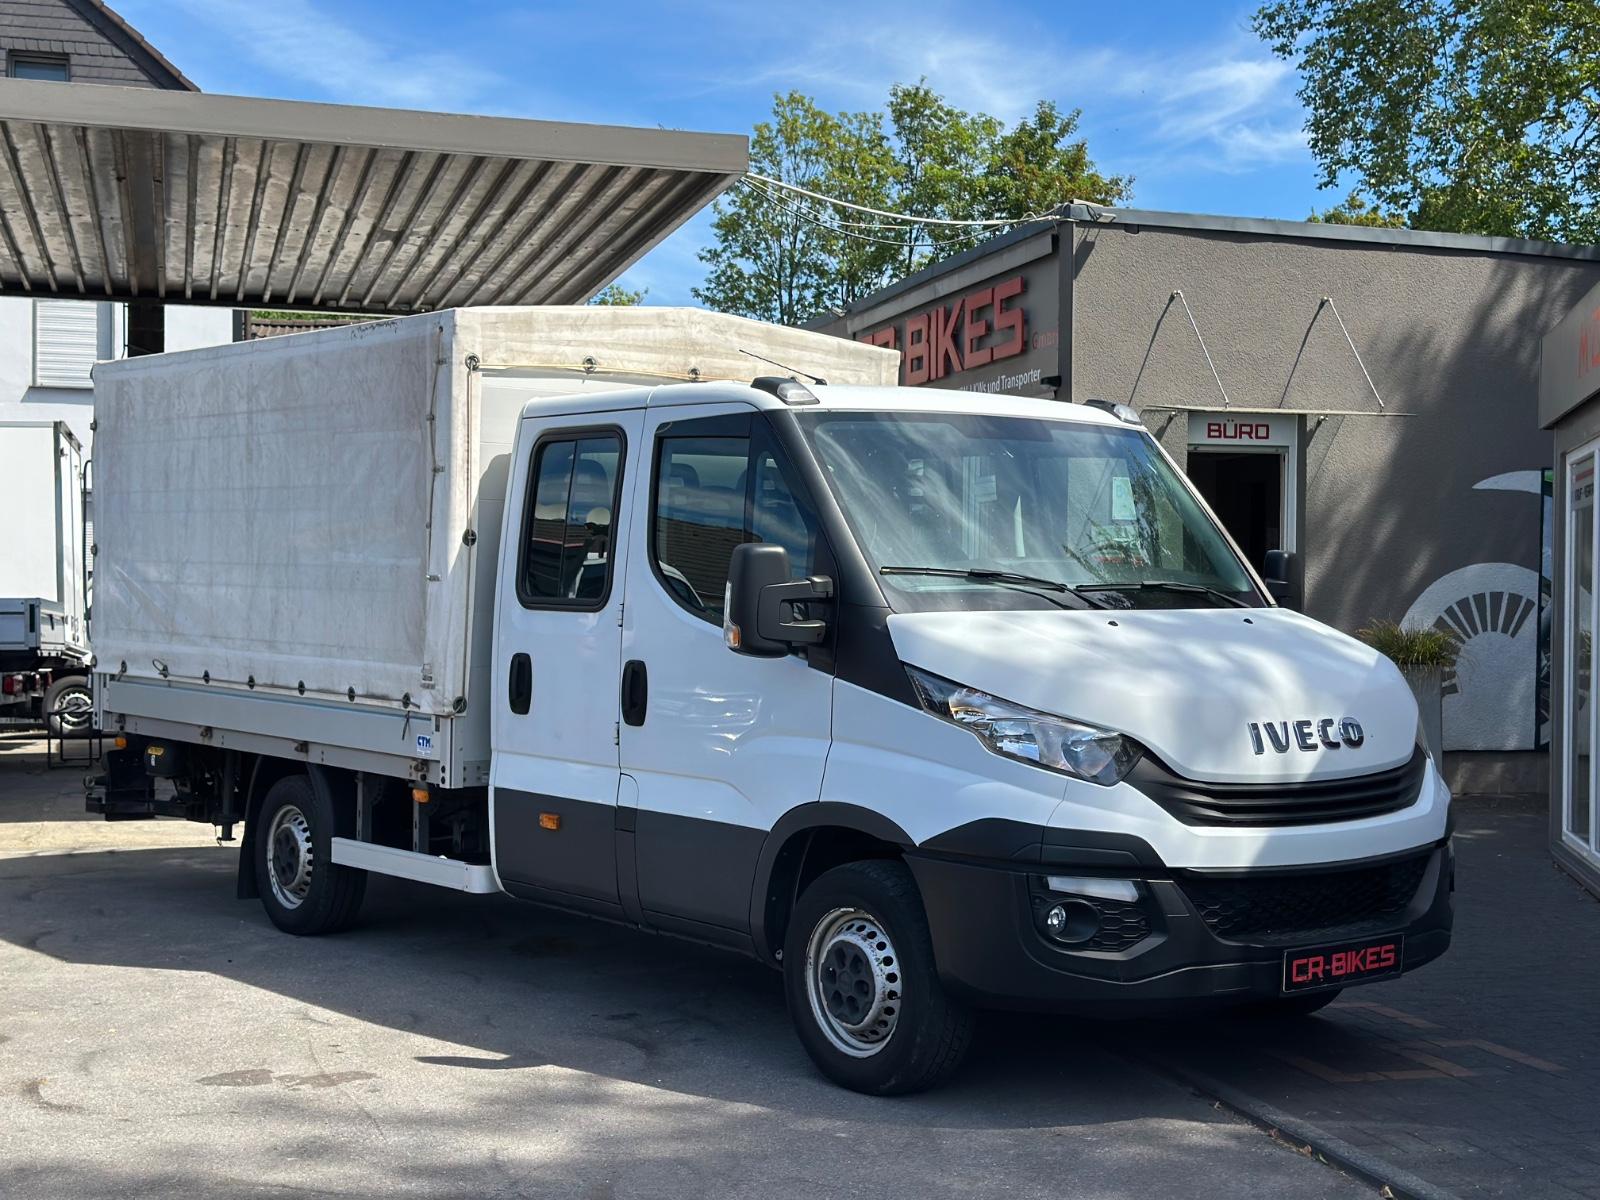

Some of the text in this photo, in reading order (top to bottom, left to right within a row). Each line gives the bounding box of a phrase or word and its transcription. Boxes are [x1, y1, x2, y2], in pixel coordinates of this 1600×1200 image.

[857, 276, 1024, 386] -BIKES
[987, 376, 1001, 394] und
[1001, 368, 1041, 391] Transporter
[1207, 418, 1270, 440] BÜRO
[1247, 716, 1365, 755] IVECO
[1292, 944, 1395, 982] CR-BIKES
